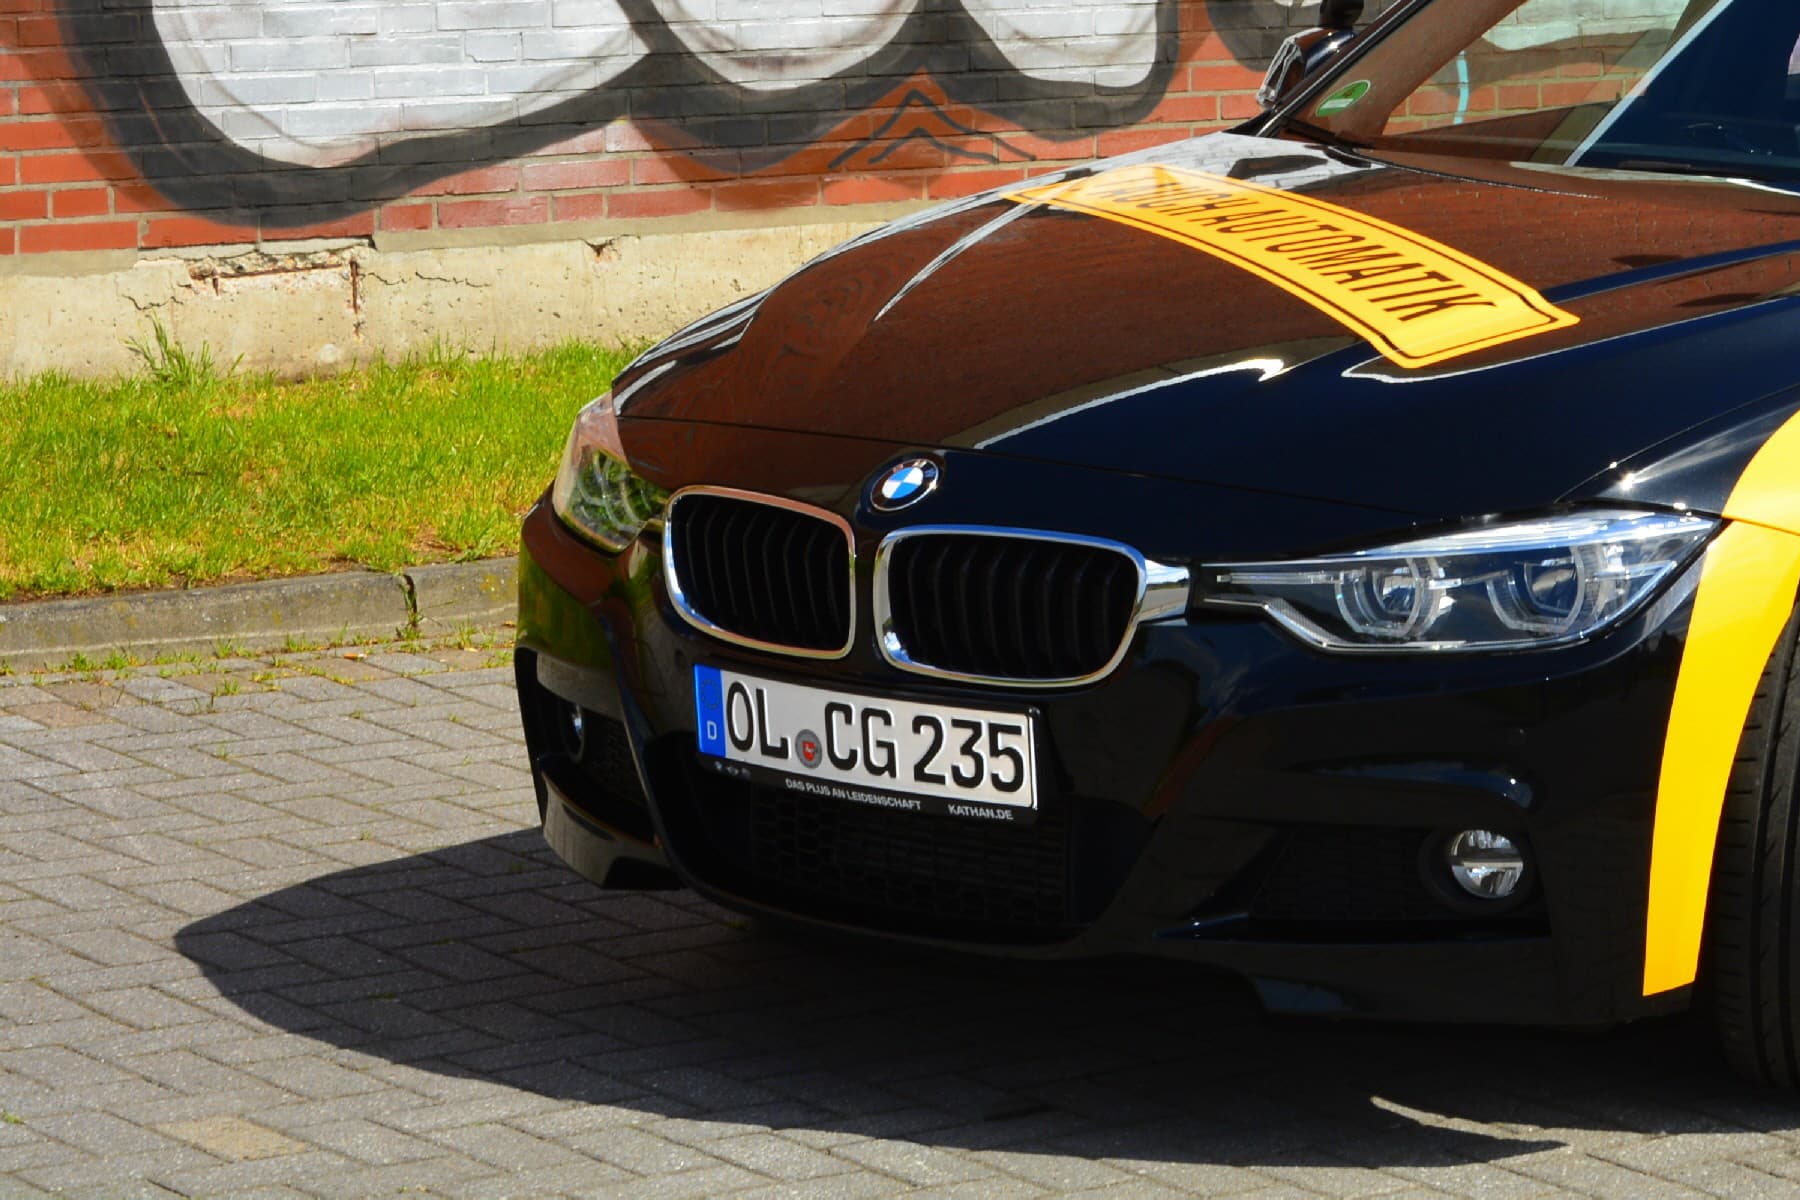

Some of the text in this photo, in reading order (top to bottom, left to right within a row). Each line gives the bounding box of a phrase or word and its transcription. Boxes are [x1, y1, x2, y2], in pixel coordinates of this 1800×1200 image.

[1187, 209, 1497, 322] AUTOMATIK
[707, 720, 717, 741] D
[726, 680, 1025, 794] OL CG 235
[785, 778, 921, 811] DAS PLUS AN LEIDENSCHAFT
[948, 803, 1014, 821] KATHAN.DE
